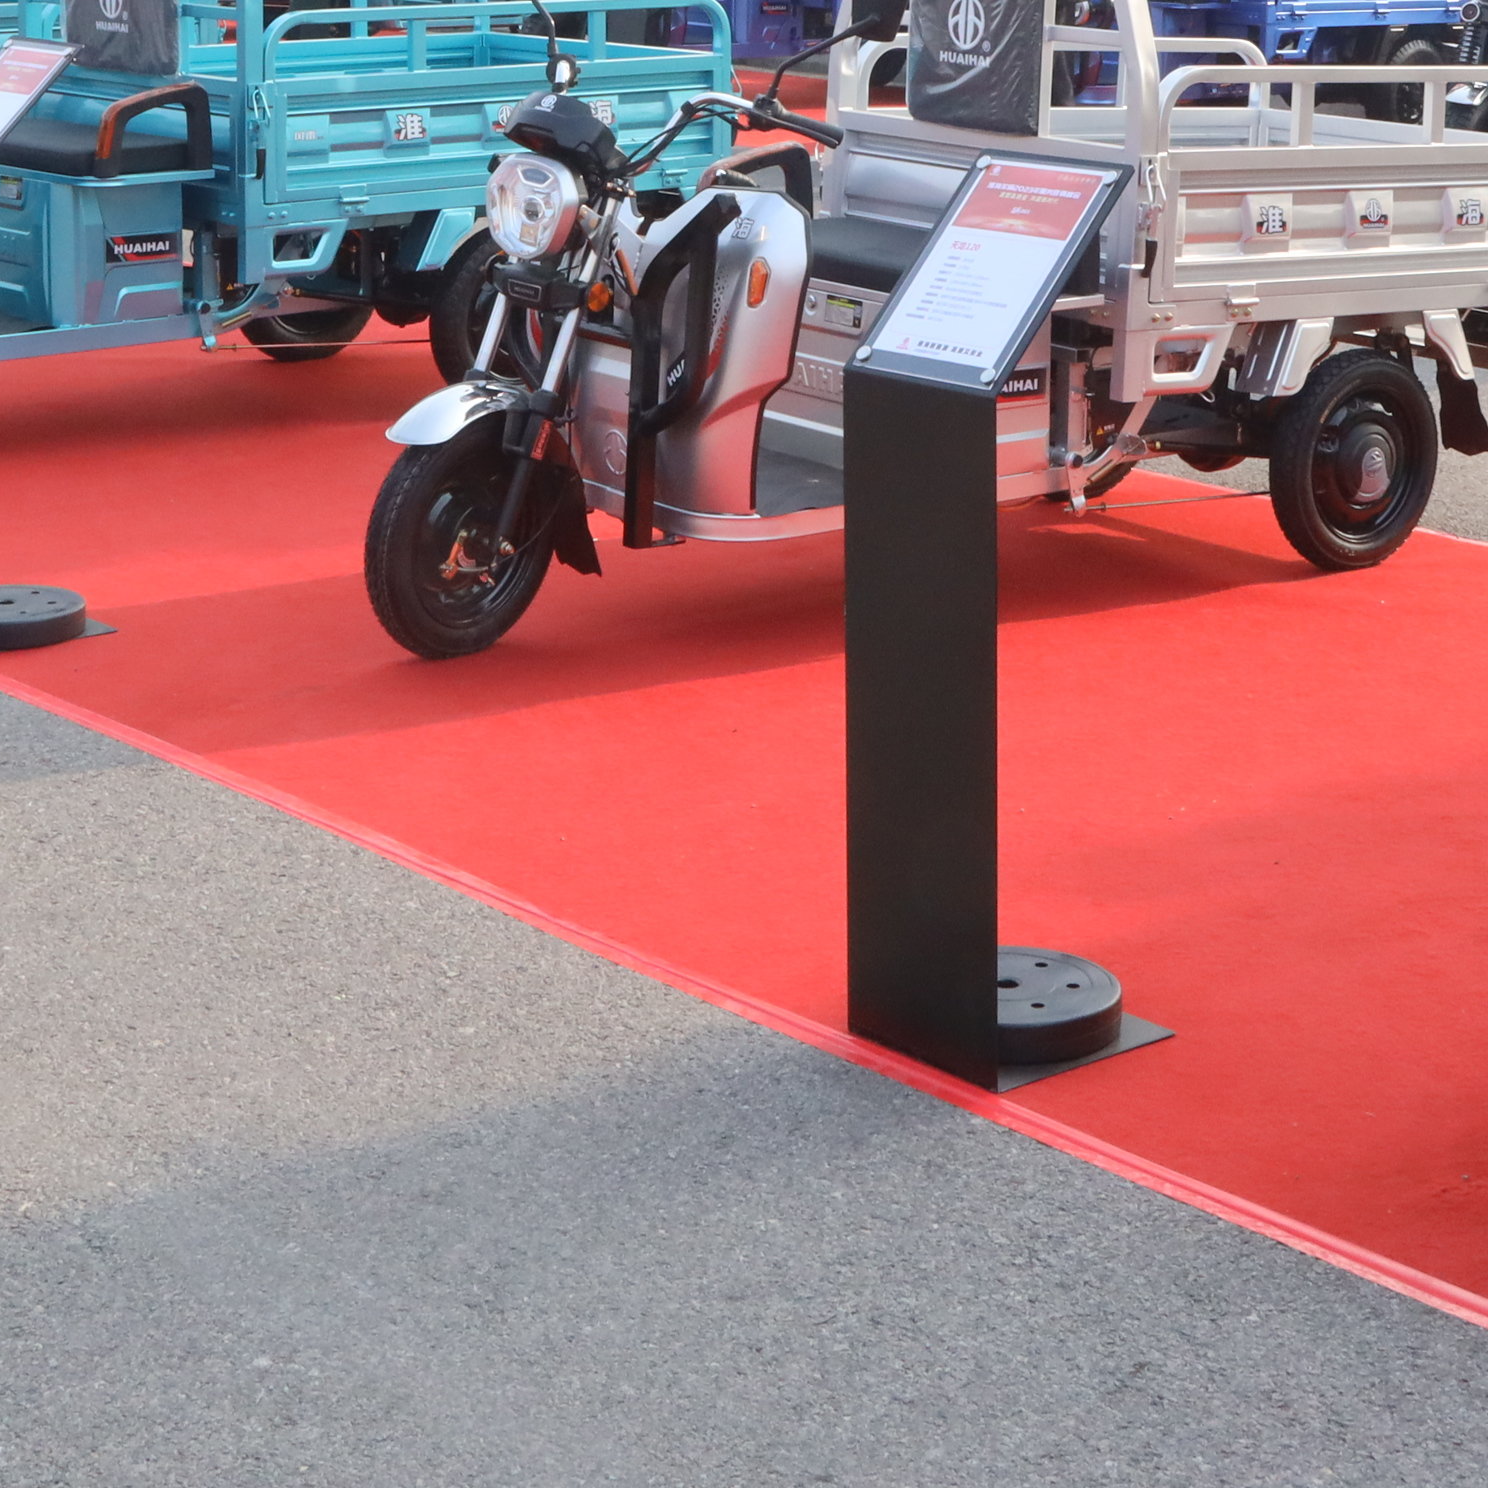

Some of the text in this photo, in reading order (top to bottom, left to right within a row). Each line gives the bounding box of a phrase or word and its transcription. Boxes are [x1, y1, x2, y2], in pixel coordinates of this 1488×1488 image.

[95, 20, 129, 34] HUAIHAI
[939, 50, 991, 68] HUAIHAI
[396, 113, 424, 141] 淮
[1260, 205, 1284, 234] 淮
[1459, 198, 1481, 226] 海
[732, 217, 755, 241] 海
[114, 240, 170, 255] HUAIHAI
